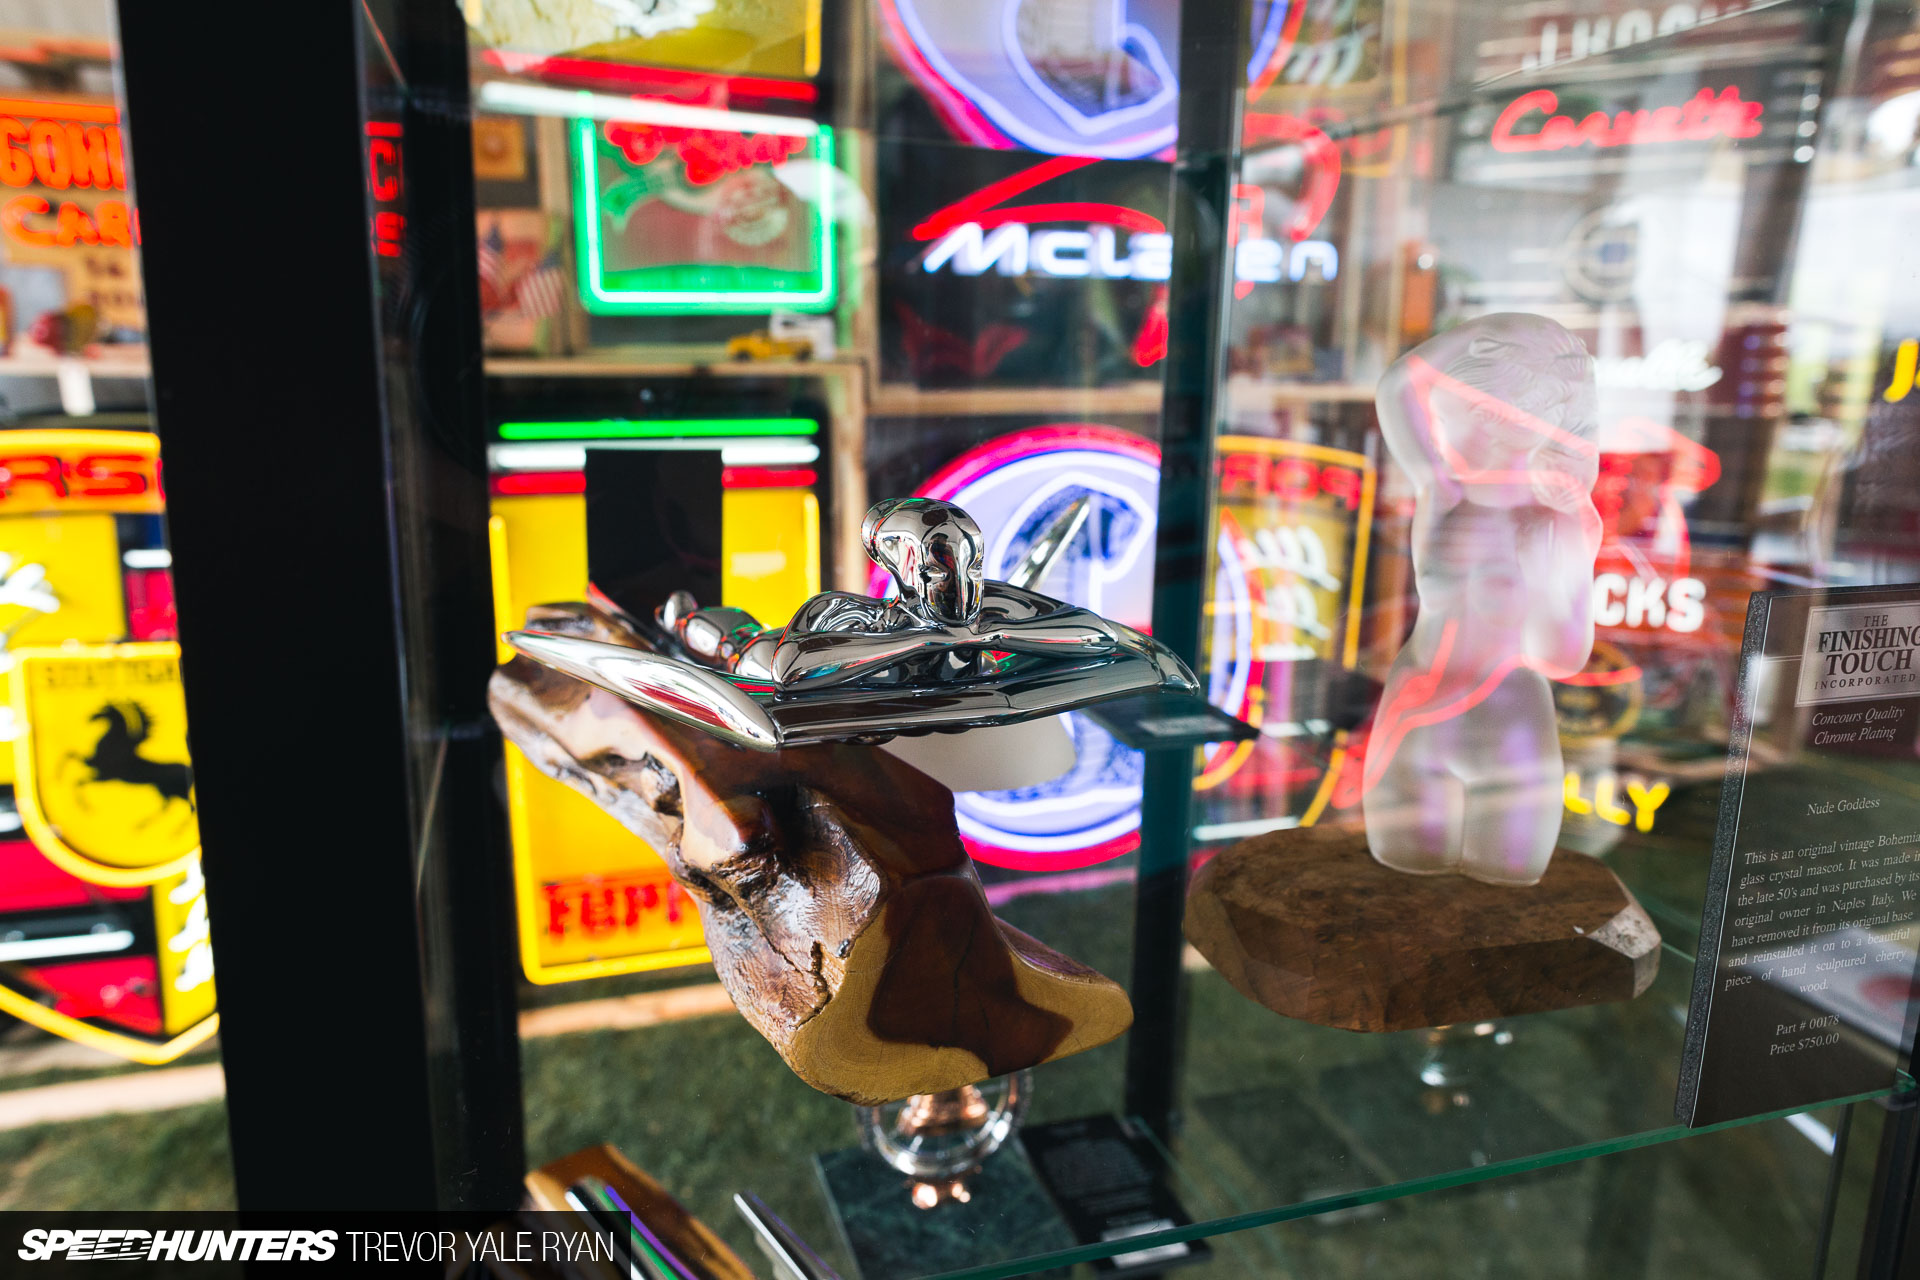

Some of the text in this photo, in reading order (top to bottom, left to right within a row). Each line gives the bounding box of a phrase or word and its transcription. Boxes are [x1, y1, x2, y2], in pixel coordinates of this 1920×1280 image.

[1864, 615, 1888, 627] THE
[1826, 649, 1915, 675] TOUCH
[1815, 674, 1916, 689] INCORPORATED
[1813, 706, 1905, 726] Concours Quality
[1814, 726, 1896, 745] Chrome Plating
[1806, 798, 1880, 815] Nude Goddess
[1744, 852, 1766, 865] This
[1770, 850, 1778, 862] is
[1782, 850, 1794, 859] an
[1798, 841, 1836, 859] original
[1840, 838, 1874, 852] vintage
[1740, 874, 1764, 889] glass
[1769, 866, 1802, 884] crystal
[1806, 863, 1844, 876] mascot.
[1849, 859, 1856, 870] It
[1861, 858, 1879, 868] was
[1883, 852, 1910, 866] made
[1738, 870, 1920, 906] the late 50's and was purchased by its
[1735, 890, 1916, 928] original owner in Naples Italy. We
[1731, 911, 1913, 947] have removed it from its original base
[1728, 928, 1910, 968] and reinstalled it on to a beautiful
[1725, 950, 1906, 991] piece of hand sculptured cherry
[1800, 978, 1828, 992] wood.
[1776, 1014, 1840, 1036] Part # 00178
[1770, 1033, 1839, 1055] Price $750.00
